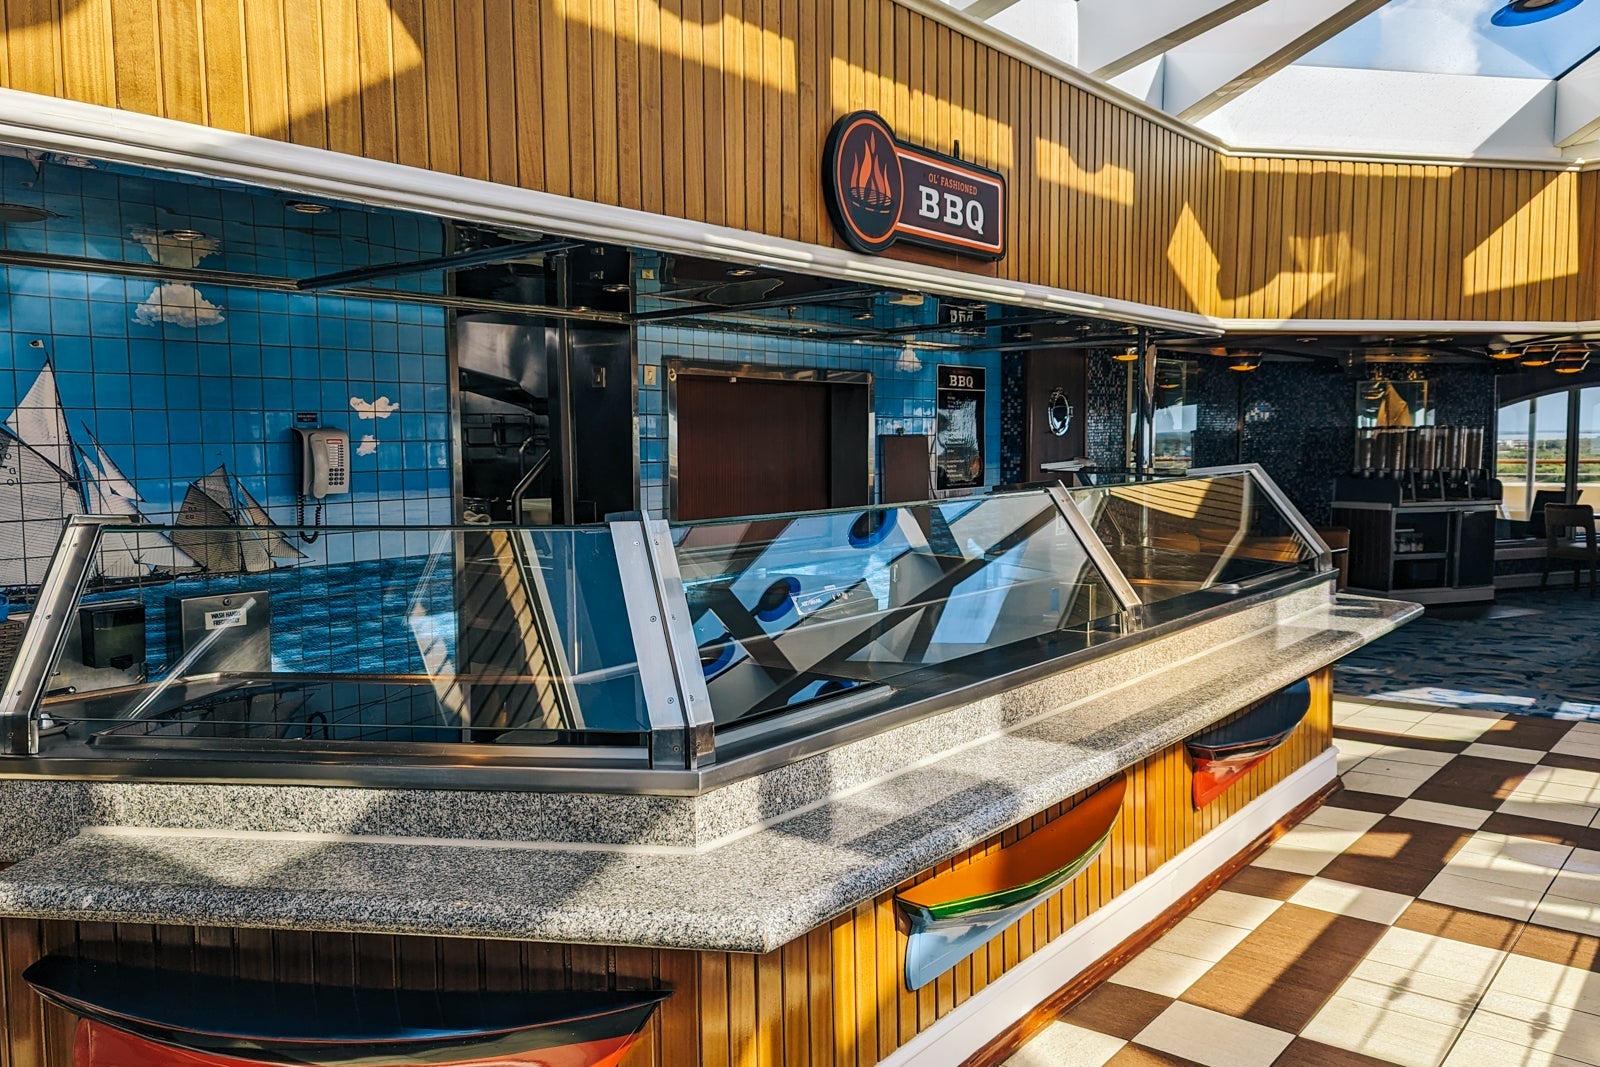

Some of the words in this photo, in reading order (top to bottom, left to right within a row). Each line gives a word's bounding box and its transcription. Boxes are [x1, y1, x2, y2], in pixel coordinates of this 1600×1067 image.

[928, 172, 940, 185] OL'
[940, 176, 978, 196] FASHIONED
[918, 185, 984, 235] BBQ
[949, 374, 974, 389] BBQ
